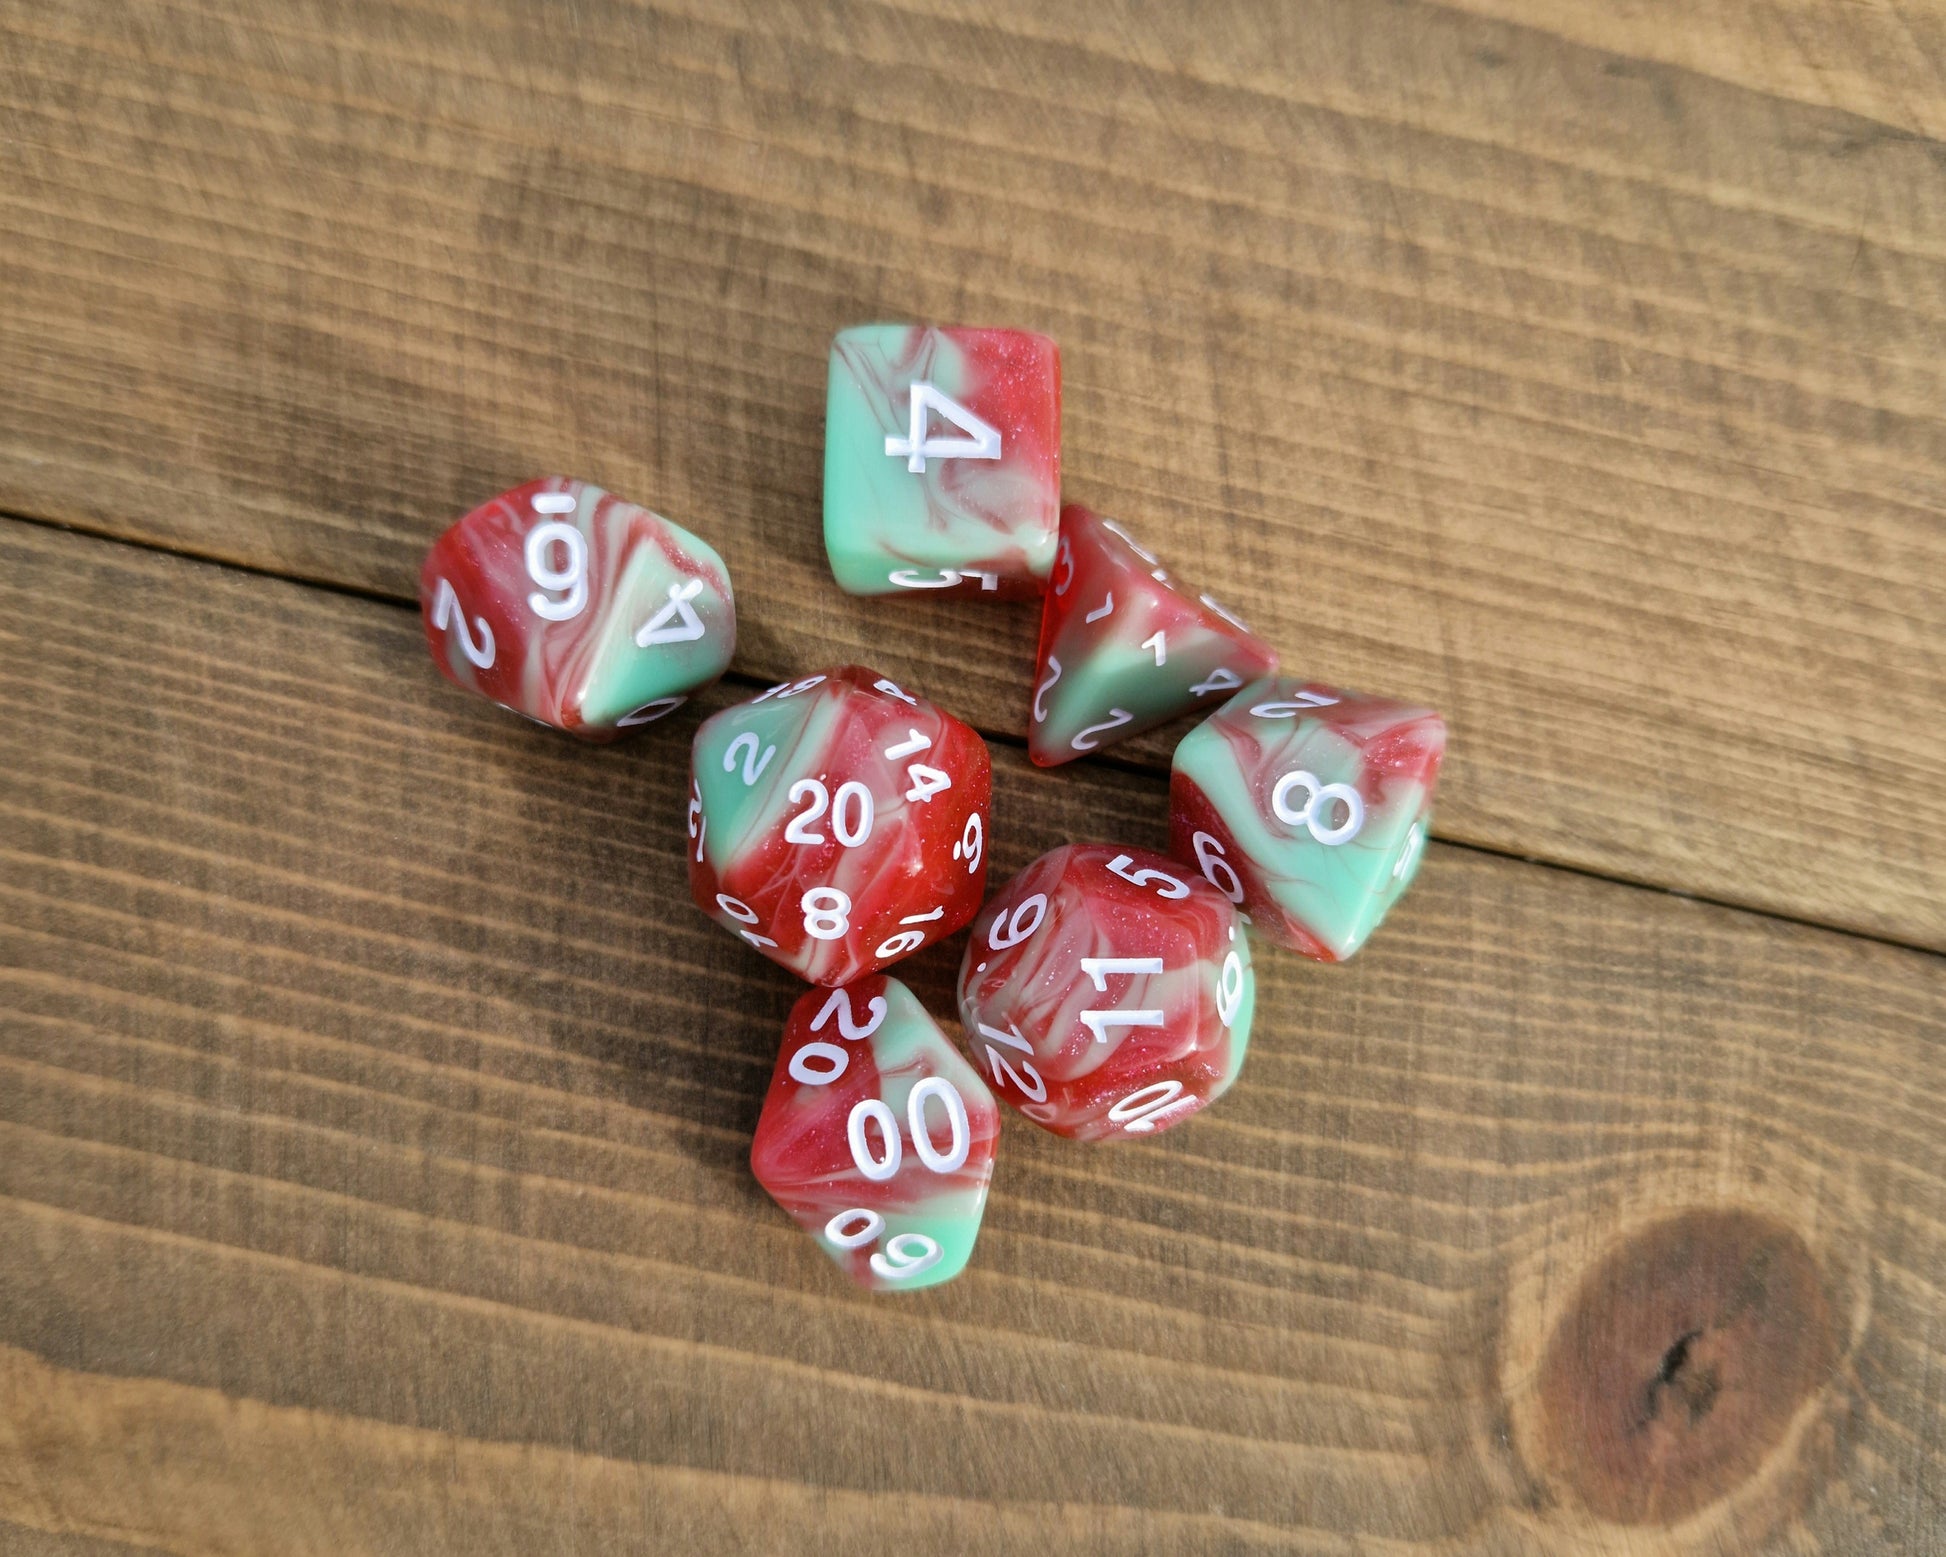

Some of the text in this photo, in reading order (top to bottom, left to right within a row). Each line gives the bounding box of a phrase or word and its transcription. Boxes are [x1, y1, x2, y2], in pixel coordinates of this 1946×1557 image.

[885, 383, 1002, 474] 4
[431, 578, 497, 669] 2
[636, 579, 706, 648] 4
[1085, 591, 1114, 624] 1
[1141, 631, 1167, 667] 1
[1188, 668, 1244, 697] 4
[1250, 692, 1340, 719] 2
[723, 732, 777, 786] 2
[884, 728, 952, 803] 14
[784, 778, 875, 848] 20
[1272, 770, 1365, 846] 8
[1105, 854, 1191, 900] 5
[801, 886, 852, 940] 8
[875, 905, 945, 959] 16
[1080, 957, 1164, 1044] 11
[788, 988, 888, 1086] 20
[978, 1024, 1048, 1103] 12
[847, 1076, 970, 1181] 00
[1107, 1079, 1199, 1133] 10
